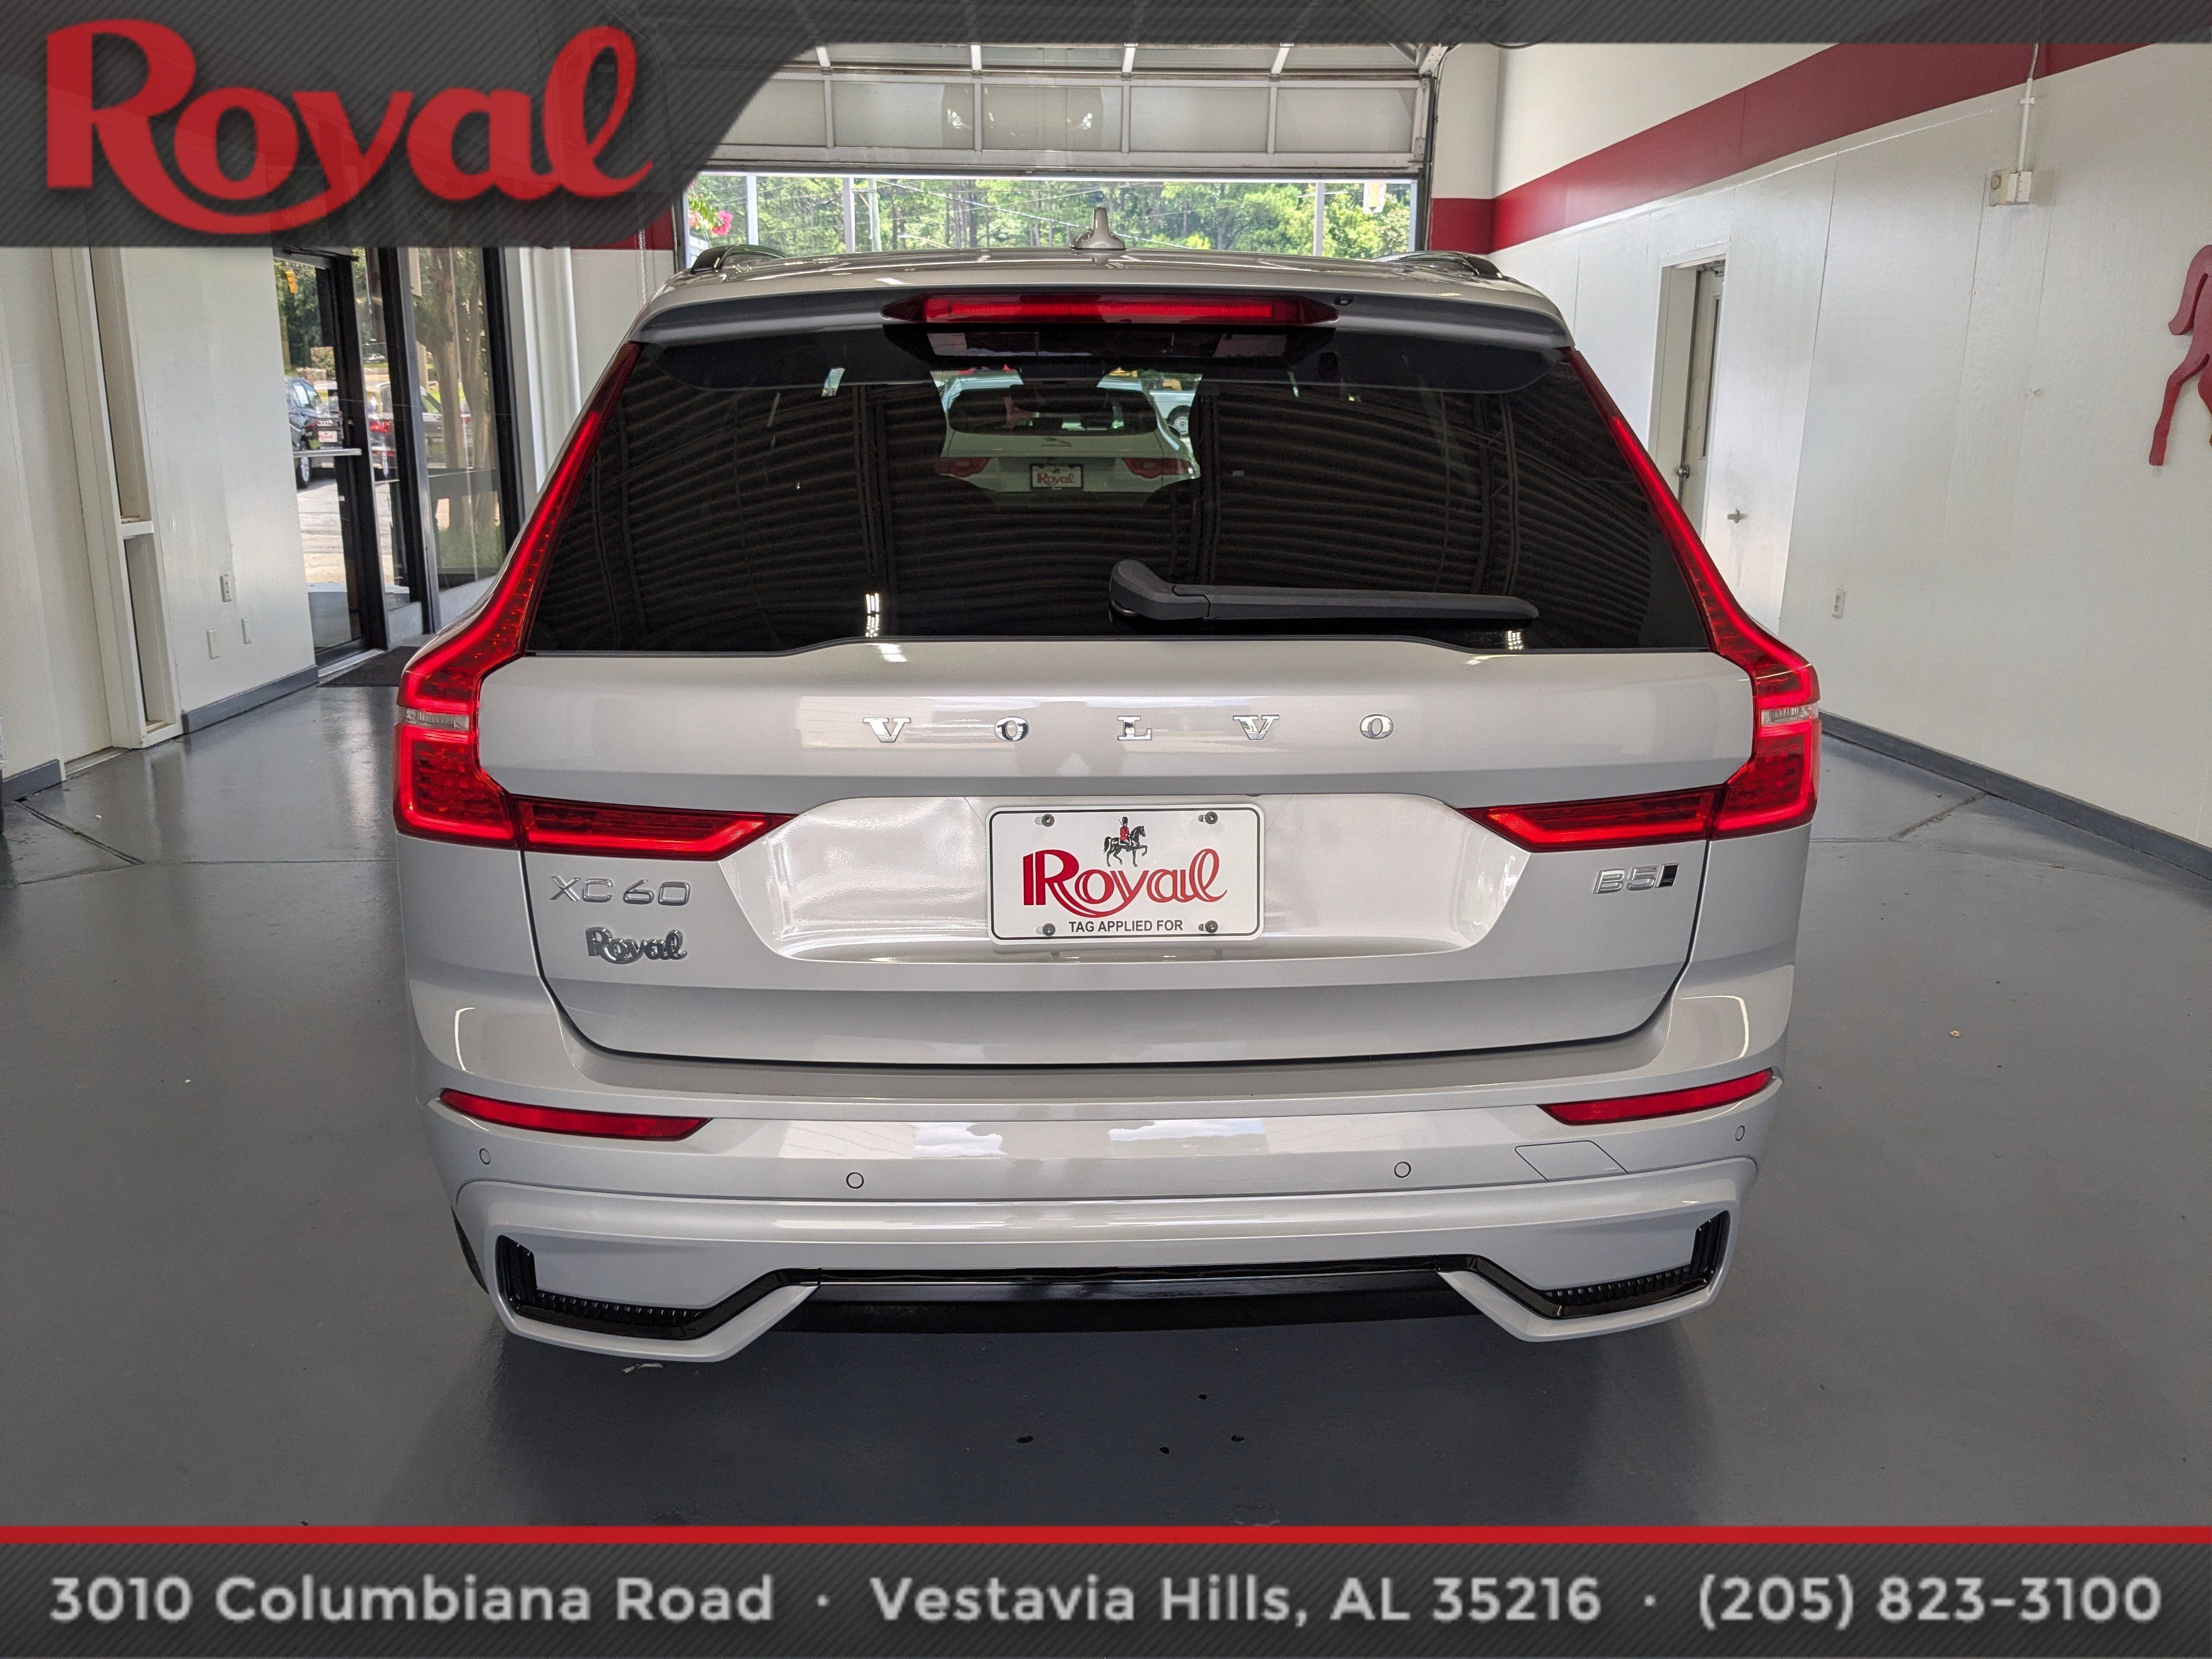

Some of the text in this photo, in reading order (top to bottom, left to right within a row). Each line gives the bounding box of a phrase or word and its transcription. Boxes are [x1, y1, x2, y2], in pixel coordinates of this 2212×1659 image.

[1037, 472, 1074, 486] Royal
[863, 714, 1394, 743] VOLVO
[1022, 848, 1228, 918] Royal
[1069, 920, 1183, 933] TAG APPLIED FOR
[585, 927, 687, 964] Royal
